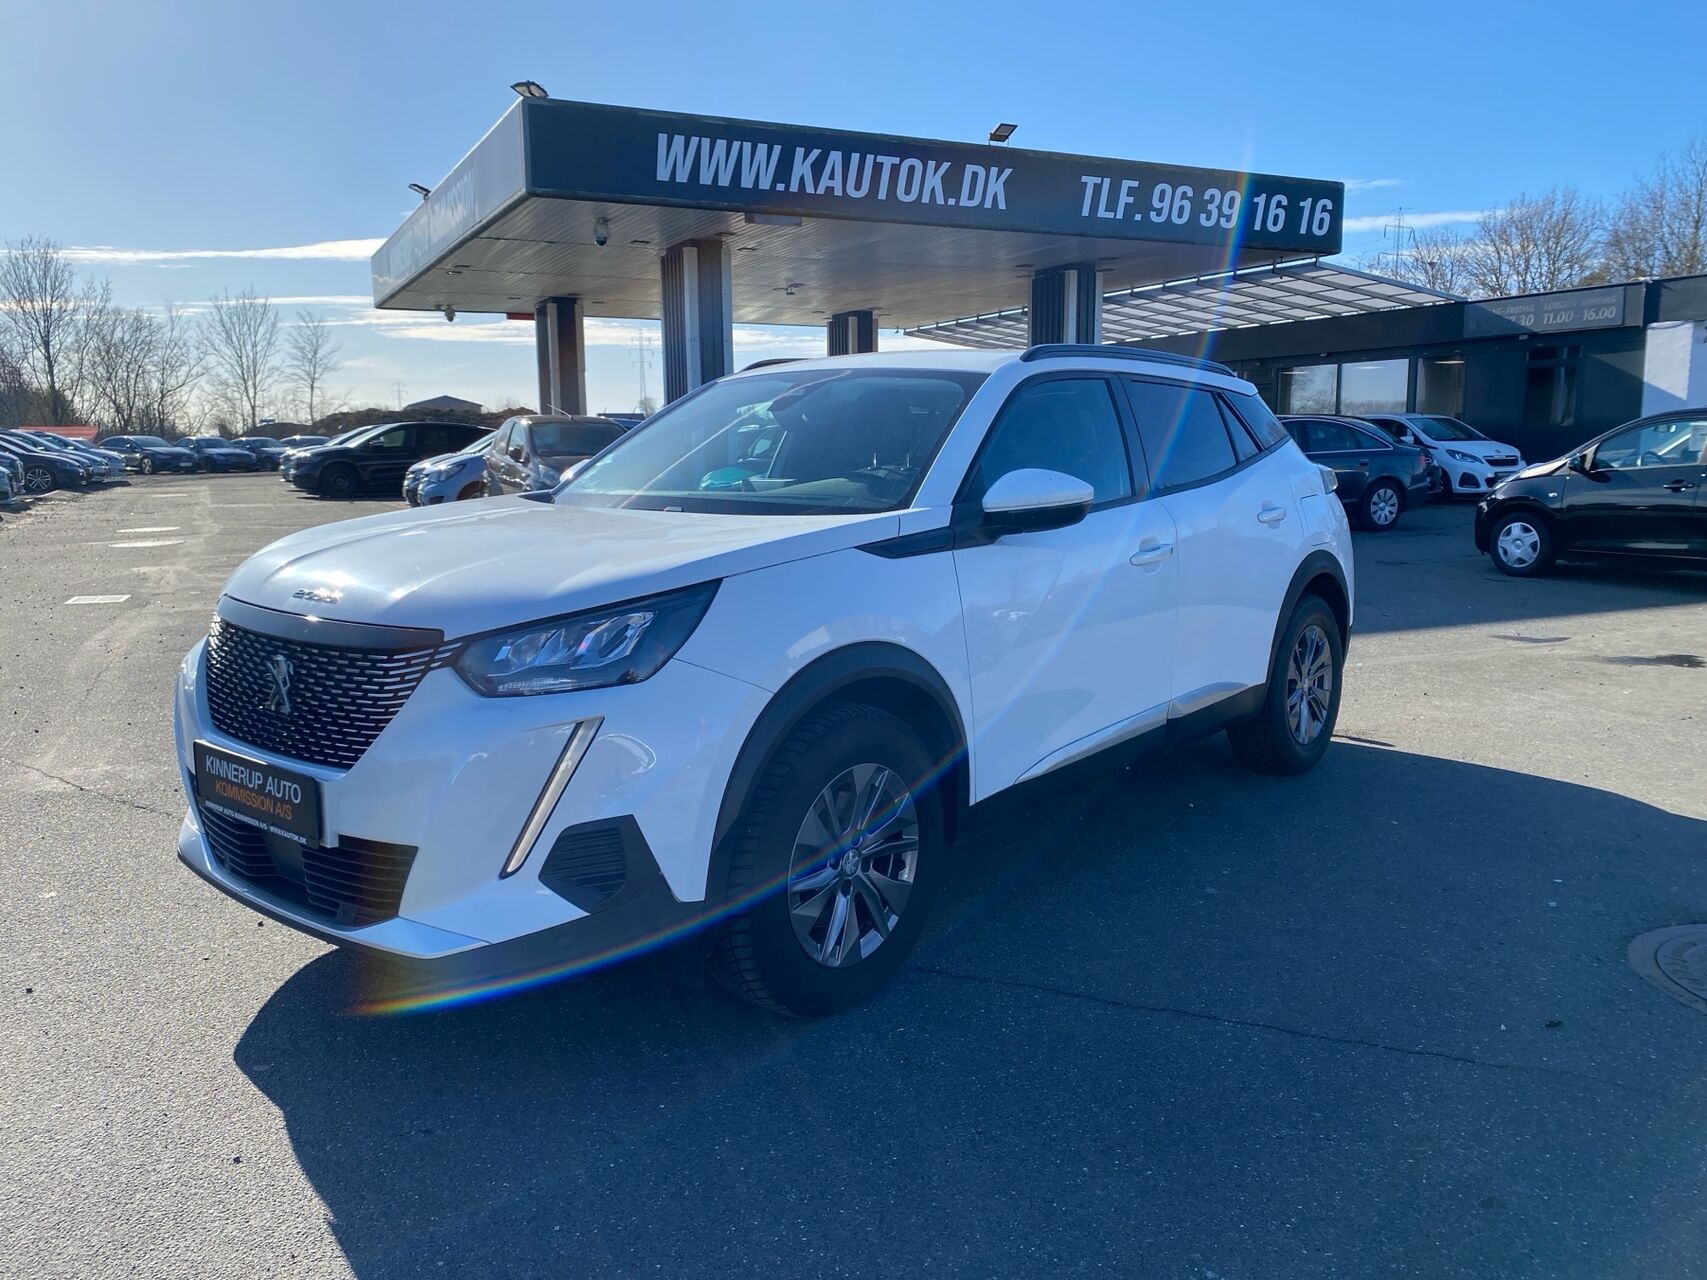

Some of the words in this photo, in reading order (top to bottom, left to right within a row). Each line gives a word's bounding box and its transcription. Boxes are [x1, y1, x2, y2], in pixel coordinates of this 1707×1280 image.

[656, 132, 1014, 210] WWW.KAUTOK.DK
[1081, 175, 1142, 221] TLF.
[1150, 183, 1194, 224] 96
[1200, 188, 1242, 229] 39
[1253, 193, 1288, 232] 16
[1299, 197, 1333, 236] 16
[205, 754, 263, 790] KINNERUP
[265, 776, 302, 804] AUTO
[215, 780, 274, 814] KOMMISSION
[275, 801, 292, 820] A/S
